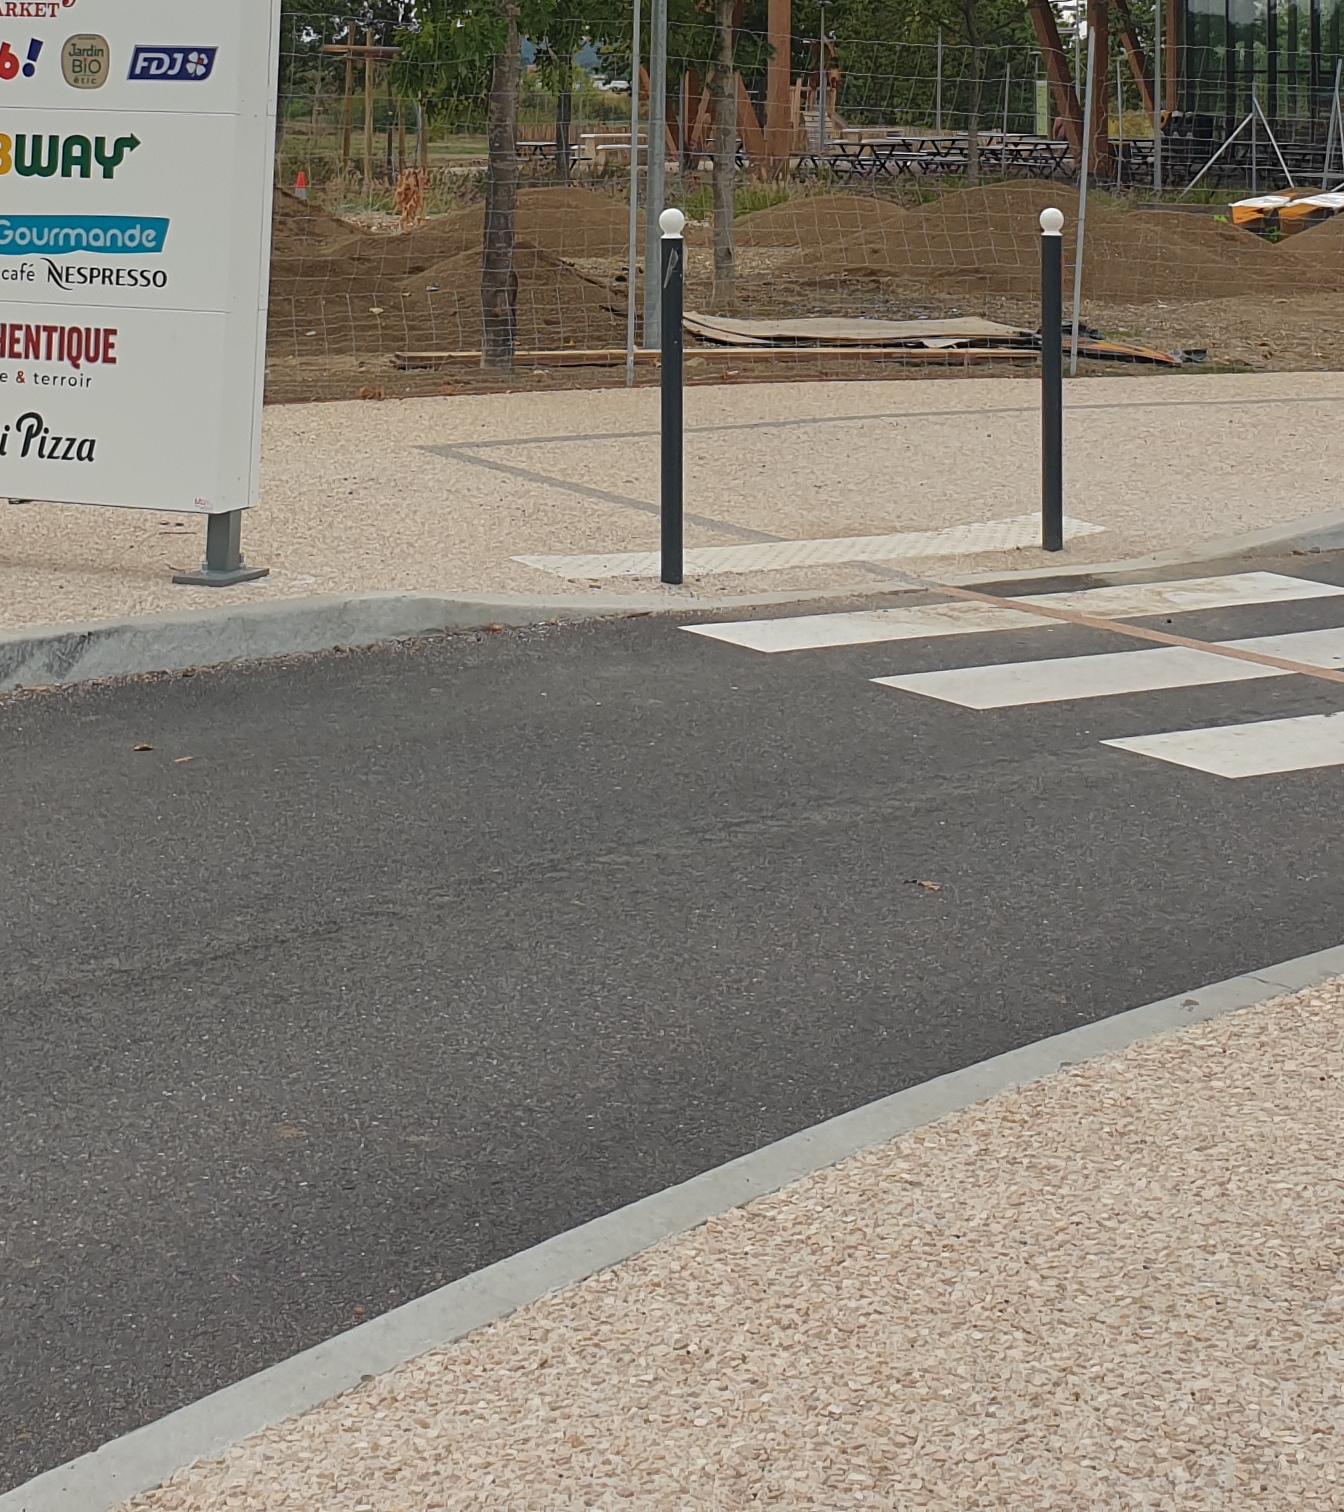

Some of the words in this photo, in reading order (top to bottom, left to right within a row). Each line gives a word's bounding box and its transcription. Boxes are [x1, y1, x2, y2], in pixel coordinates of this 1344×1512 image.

[68, 43, 104, 58] Jardin
[134, 52, 185, 76] FDJ
[1, 263, 36, 282] café
[40, 257, 169, 291] NESPRESSO
[15, 370, 27, 384] &
[33, 371, 93, 388] terroir
[15, 411, 97, 463] Pizza
